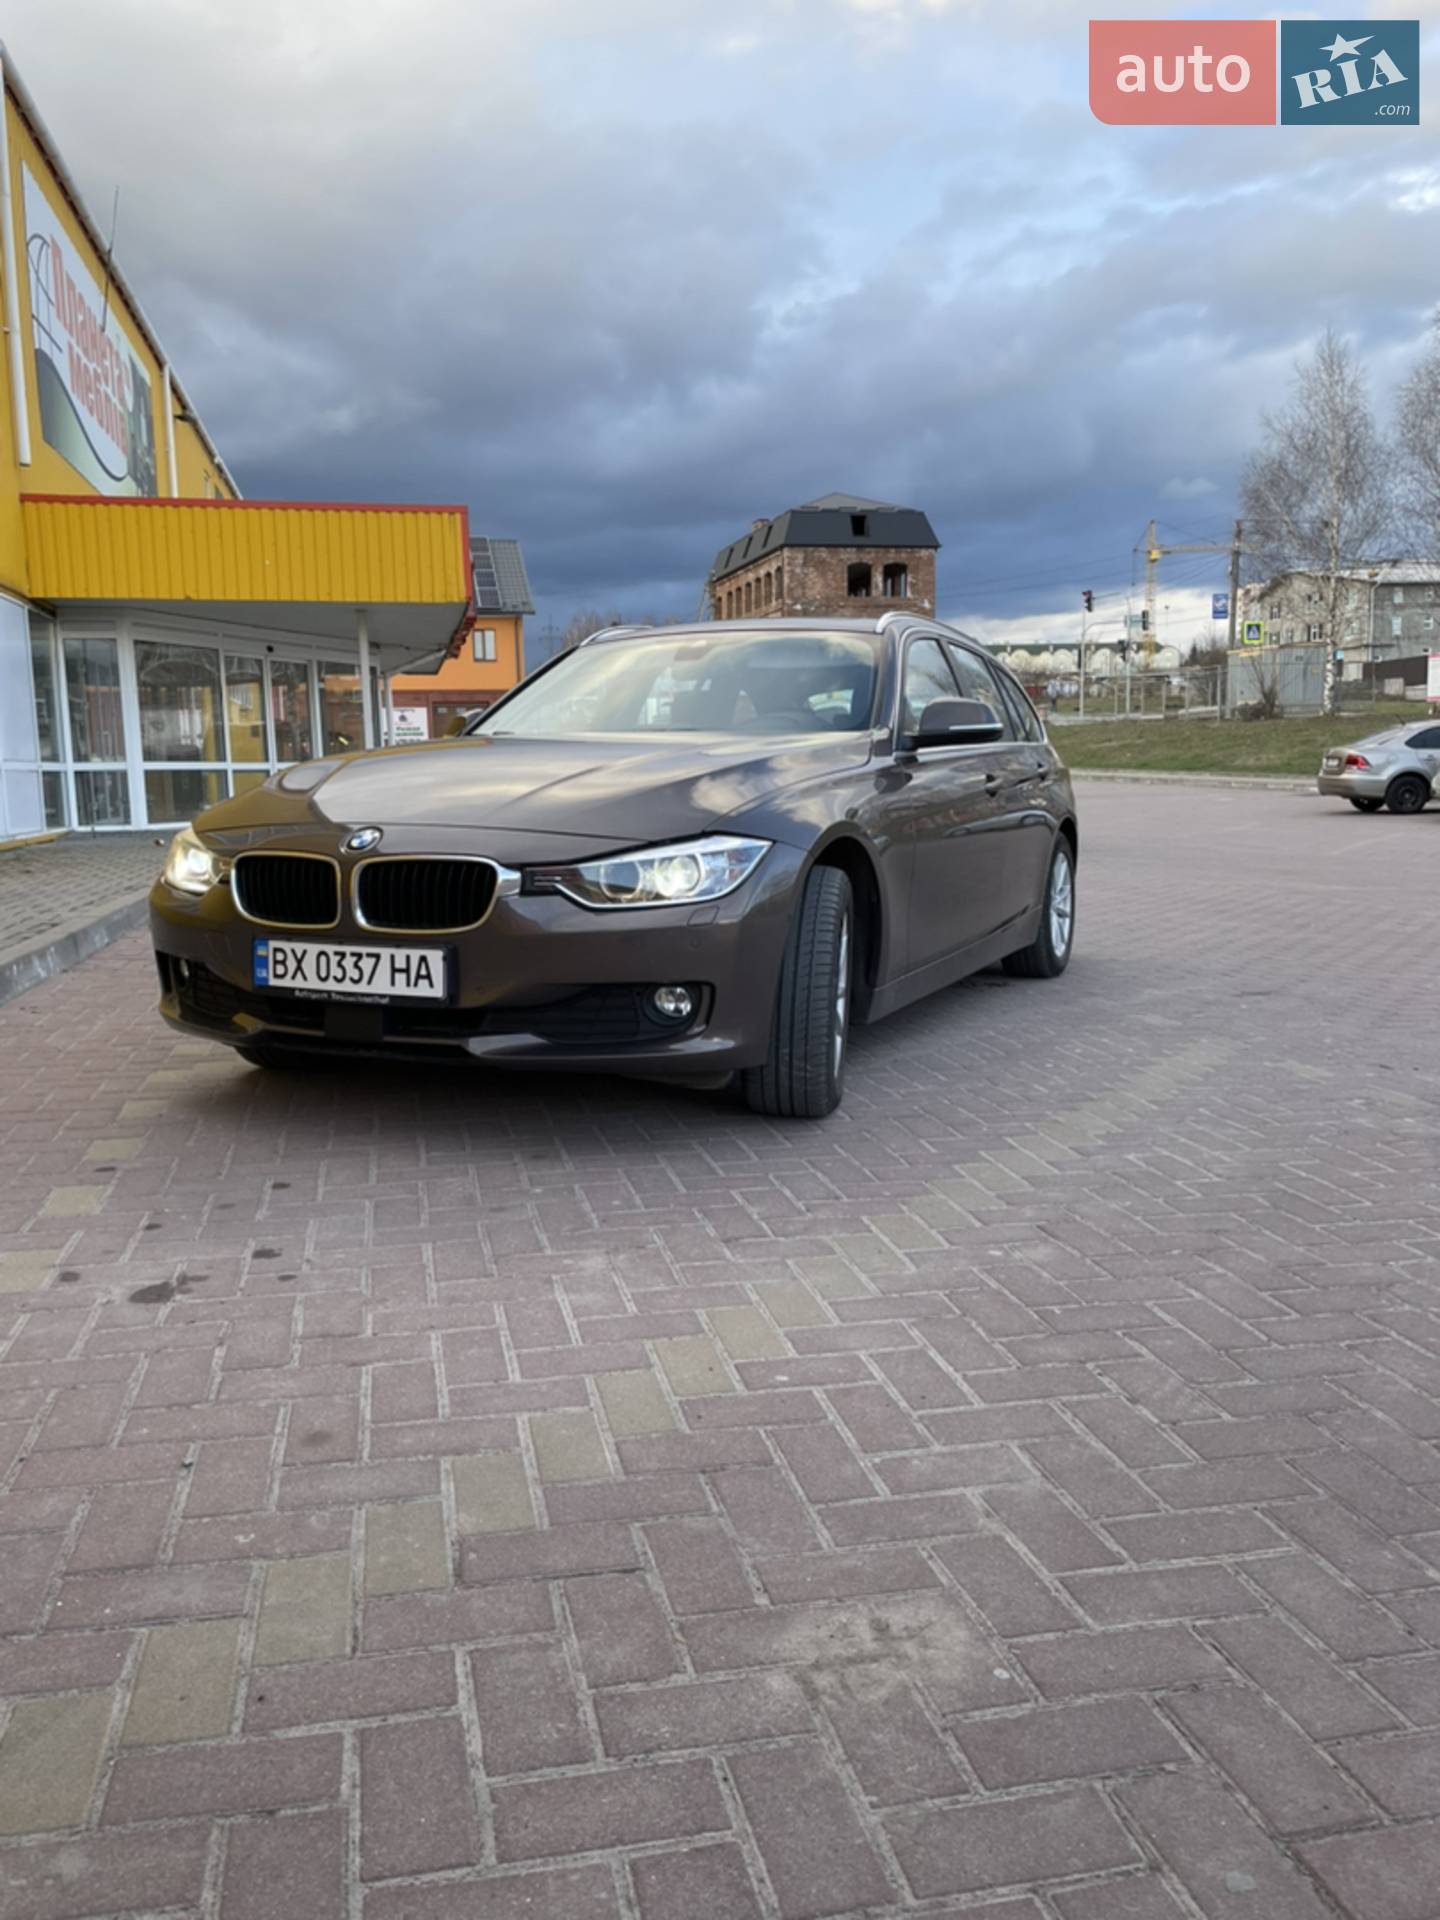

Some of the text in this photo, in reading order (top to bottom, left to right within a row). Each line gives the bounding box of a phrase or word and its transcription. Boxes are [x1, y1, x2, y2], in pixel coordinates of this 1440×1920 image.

[272, 947, 434, 989] BX 0337 HA
